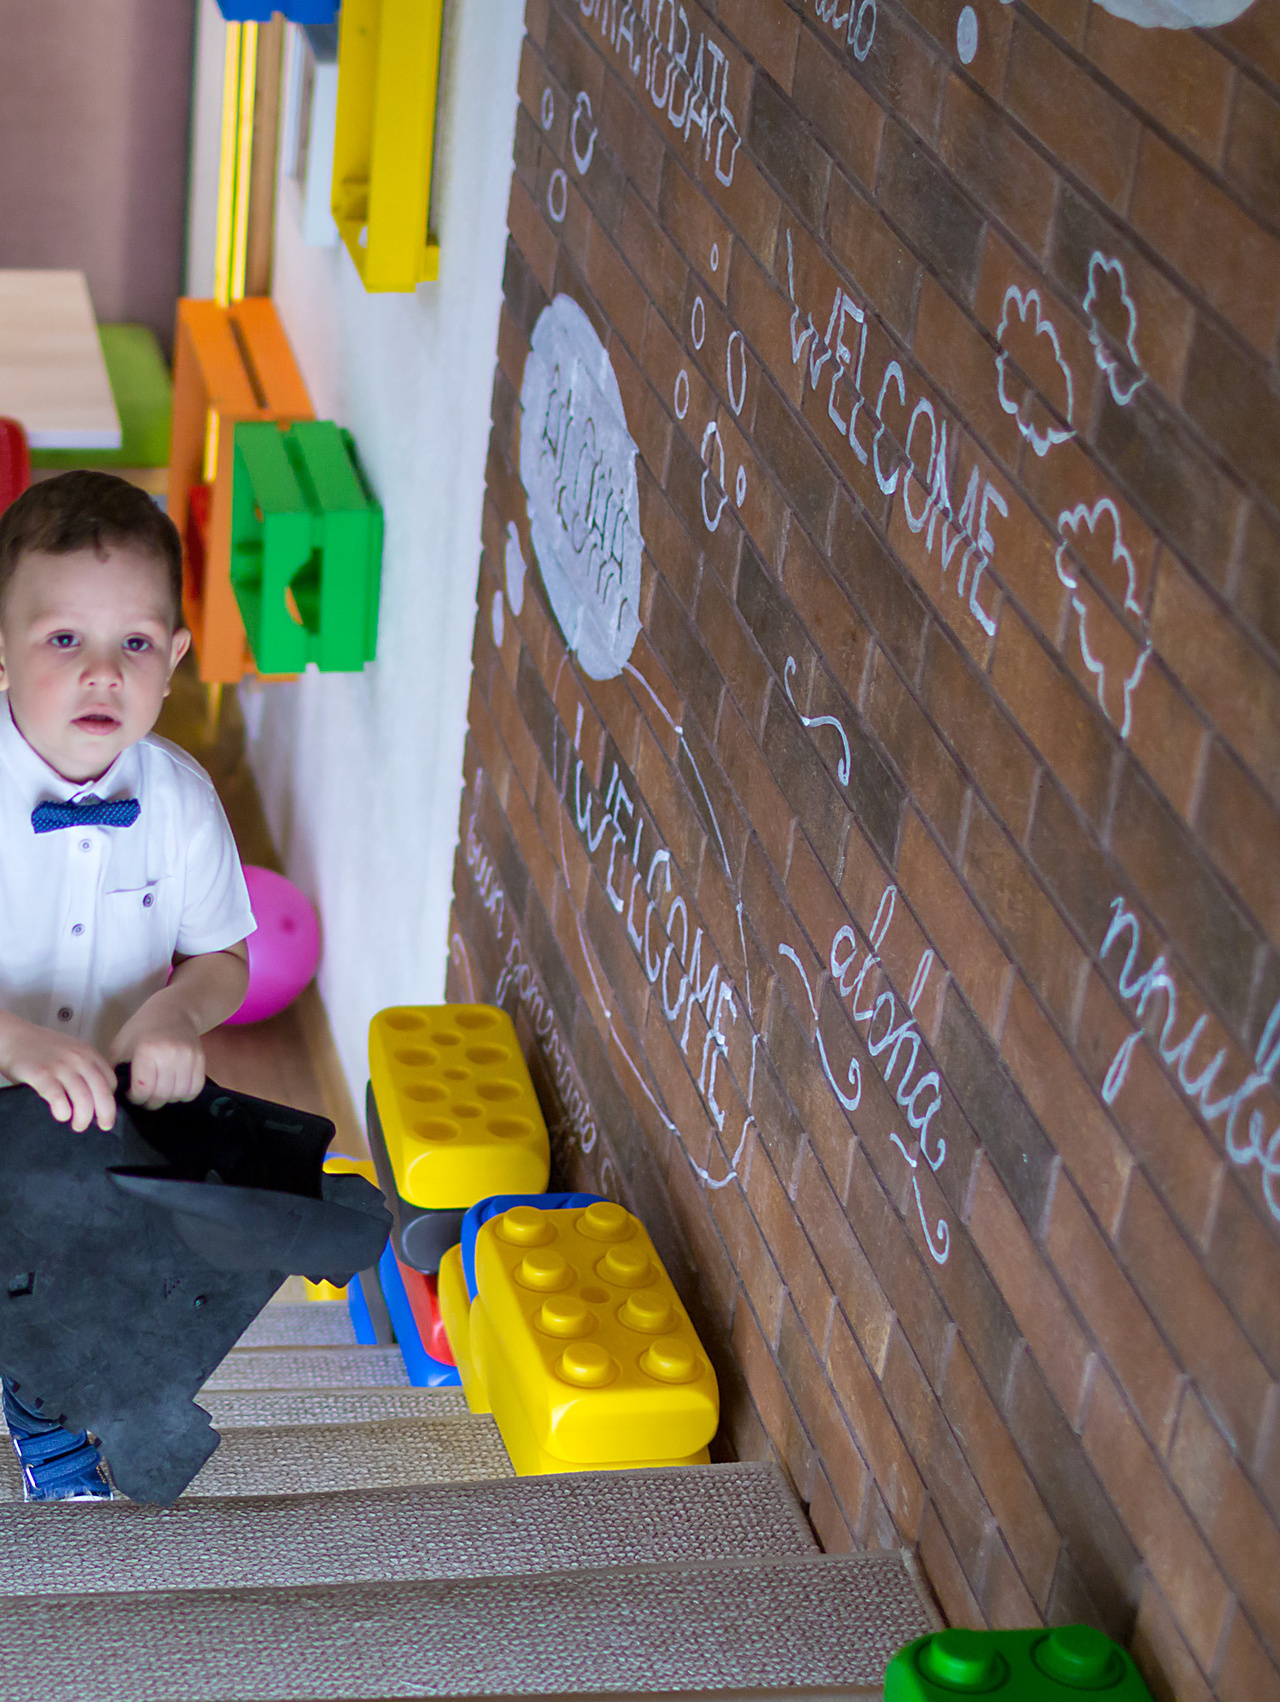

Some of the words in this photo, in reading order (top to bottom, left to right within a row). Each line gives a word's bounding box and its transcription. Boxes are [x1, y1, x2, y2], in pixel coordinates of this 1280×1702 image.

[786, 228, 1008, 636] WELCOME
[576, 702, 737, 1131] WELCOME
[830, 885, 946, 1171] aloha
